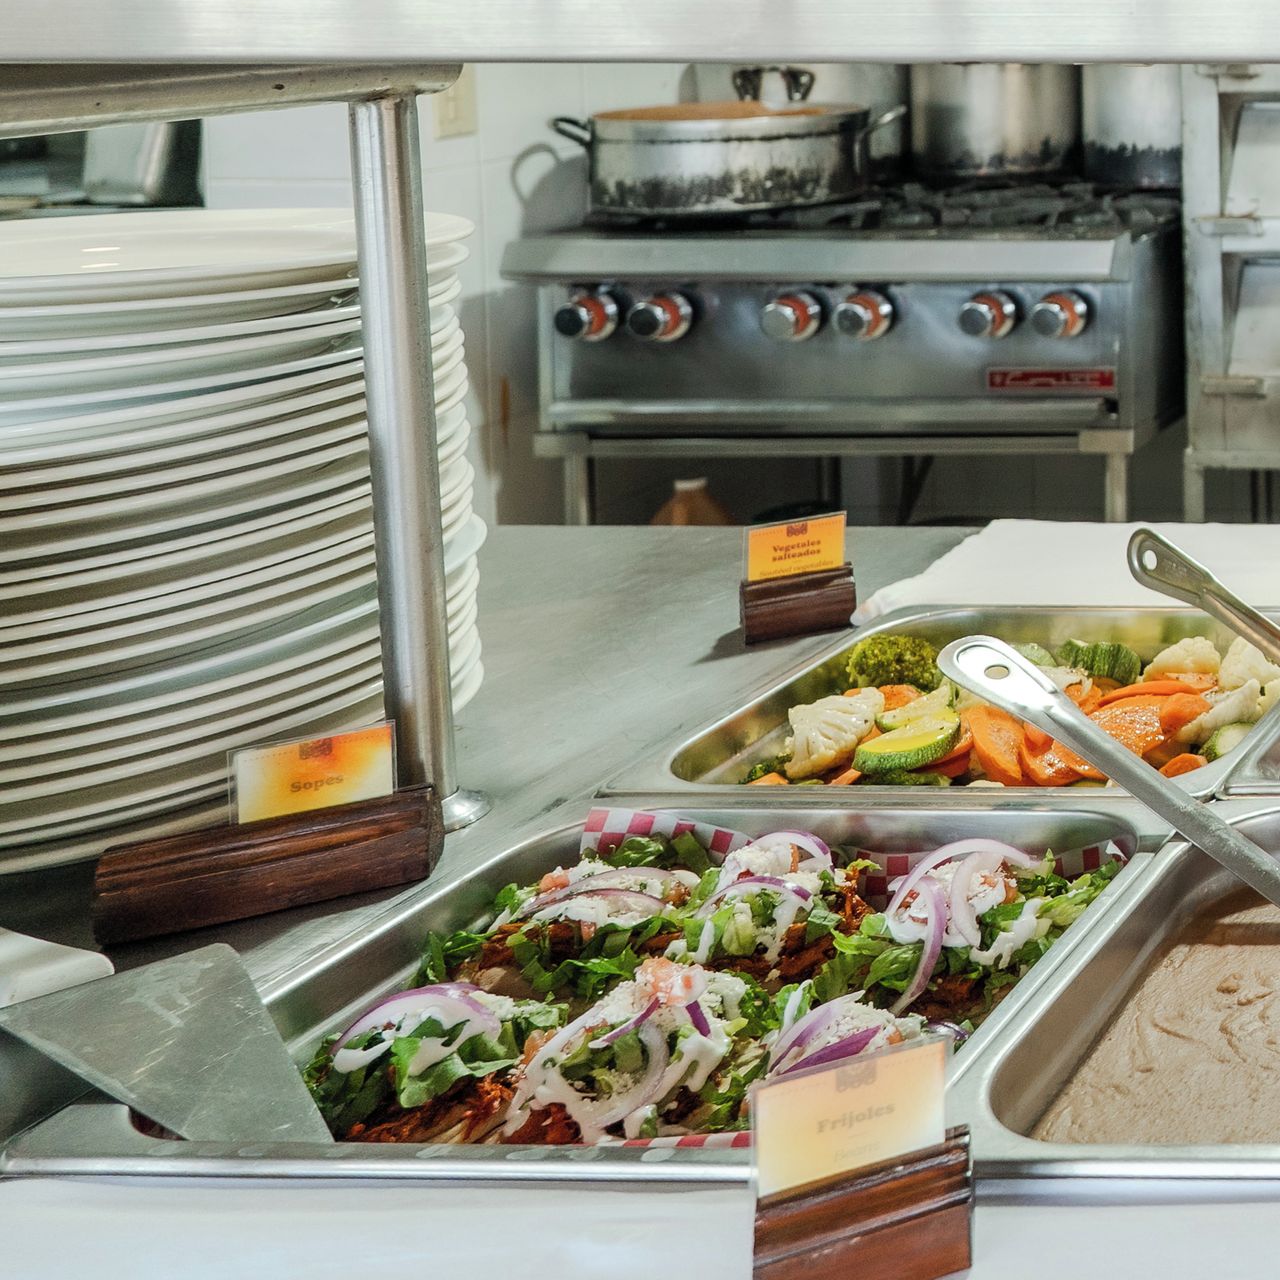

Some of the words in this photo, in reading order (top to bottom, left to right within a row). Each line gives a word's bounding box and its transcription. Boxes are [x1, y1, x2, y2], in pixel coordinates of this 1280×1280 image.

[772, 539, 822, 553] Vegetales
[772, 548, 822, 562] salteados
[290, 774, 345, 793] Sopes
[816, 1103, 896, 1134] Frijoles
